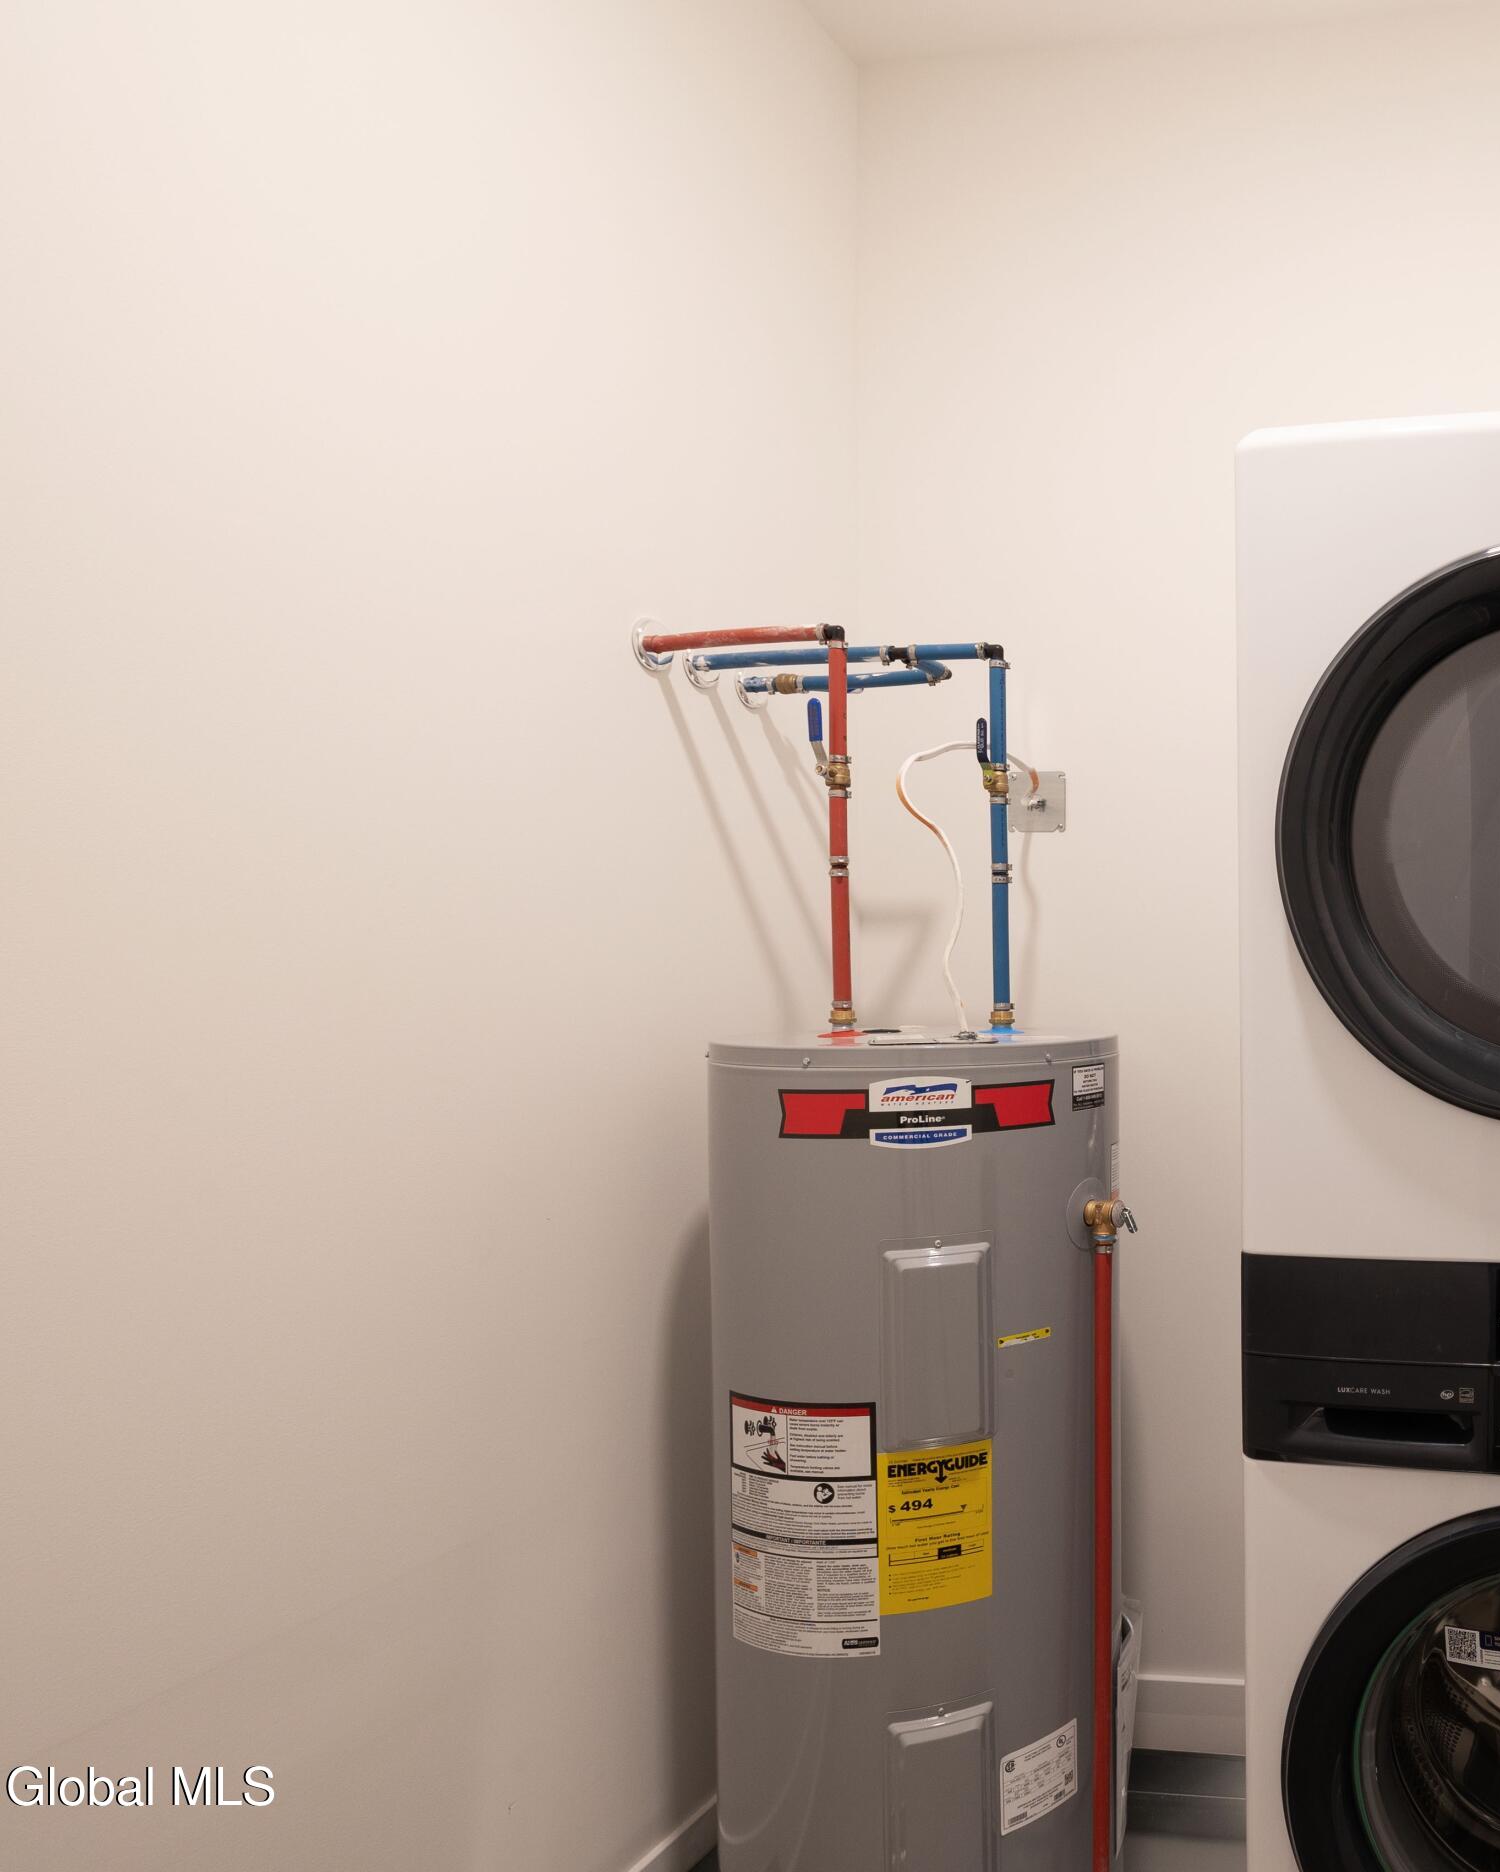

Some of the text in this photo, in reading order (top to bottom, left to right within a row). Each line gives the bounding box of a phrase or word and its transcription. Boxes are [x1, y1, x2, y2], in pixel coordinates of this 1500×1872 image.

[881, 1094, 955, 1103] american
[779, 1408, 808, 1416] DANGER
[888, 1452, 989, 1479] ENERGYGUIDE
[900, 1498, 933, 1512] 494
[767, 1535, 790, 1544] IMPORTANT
